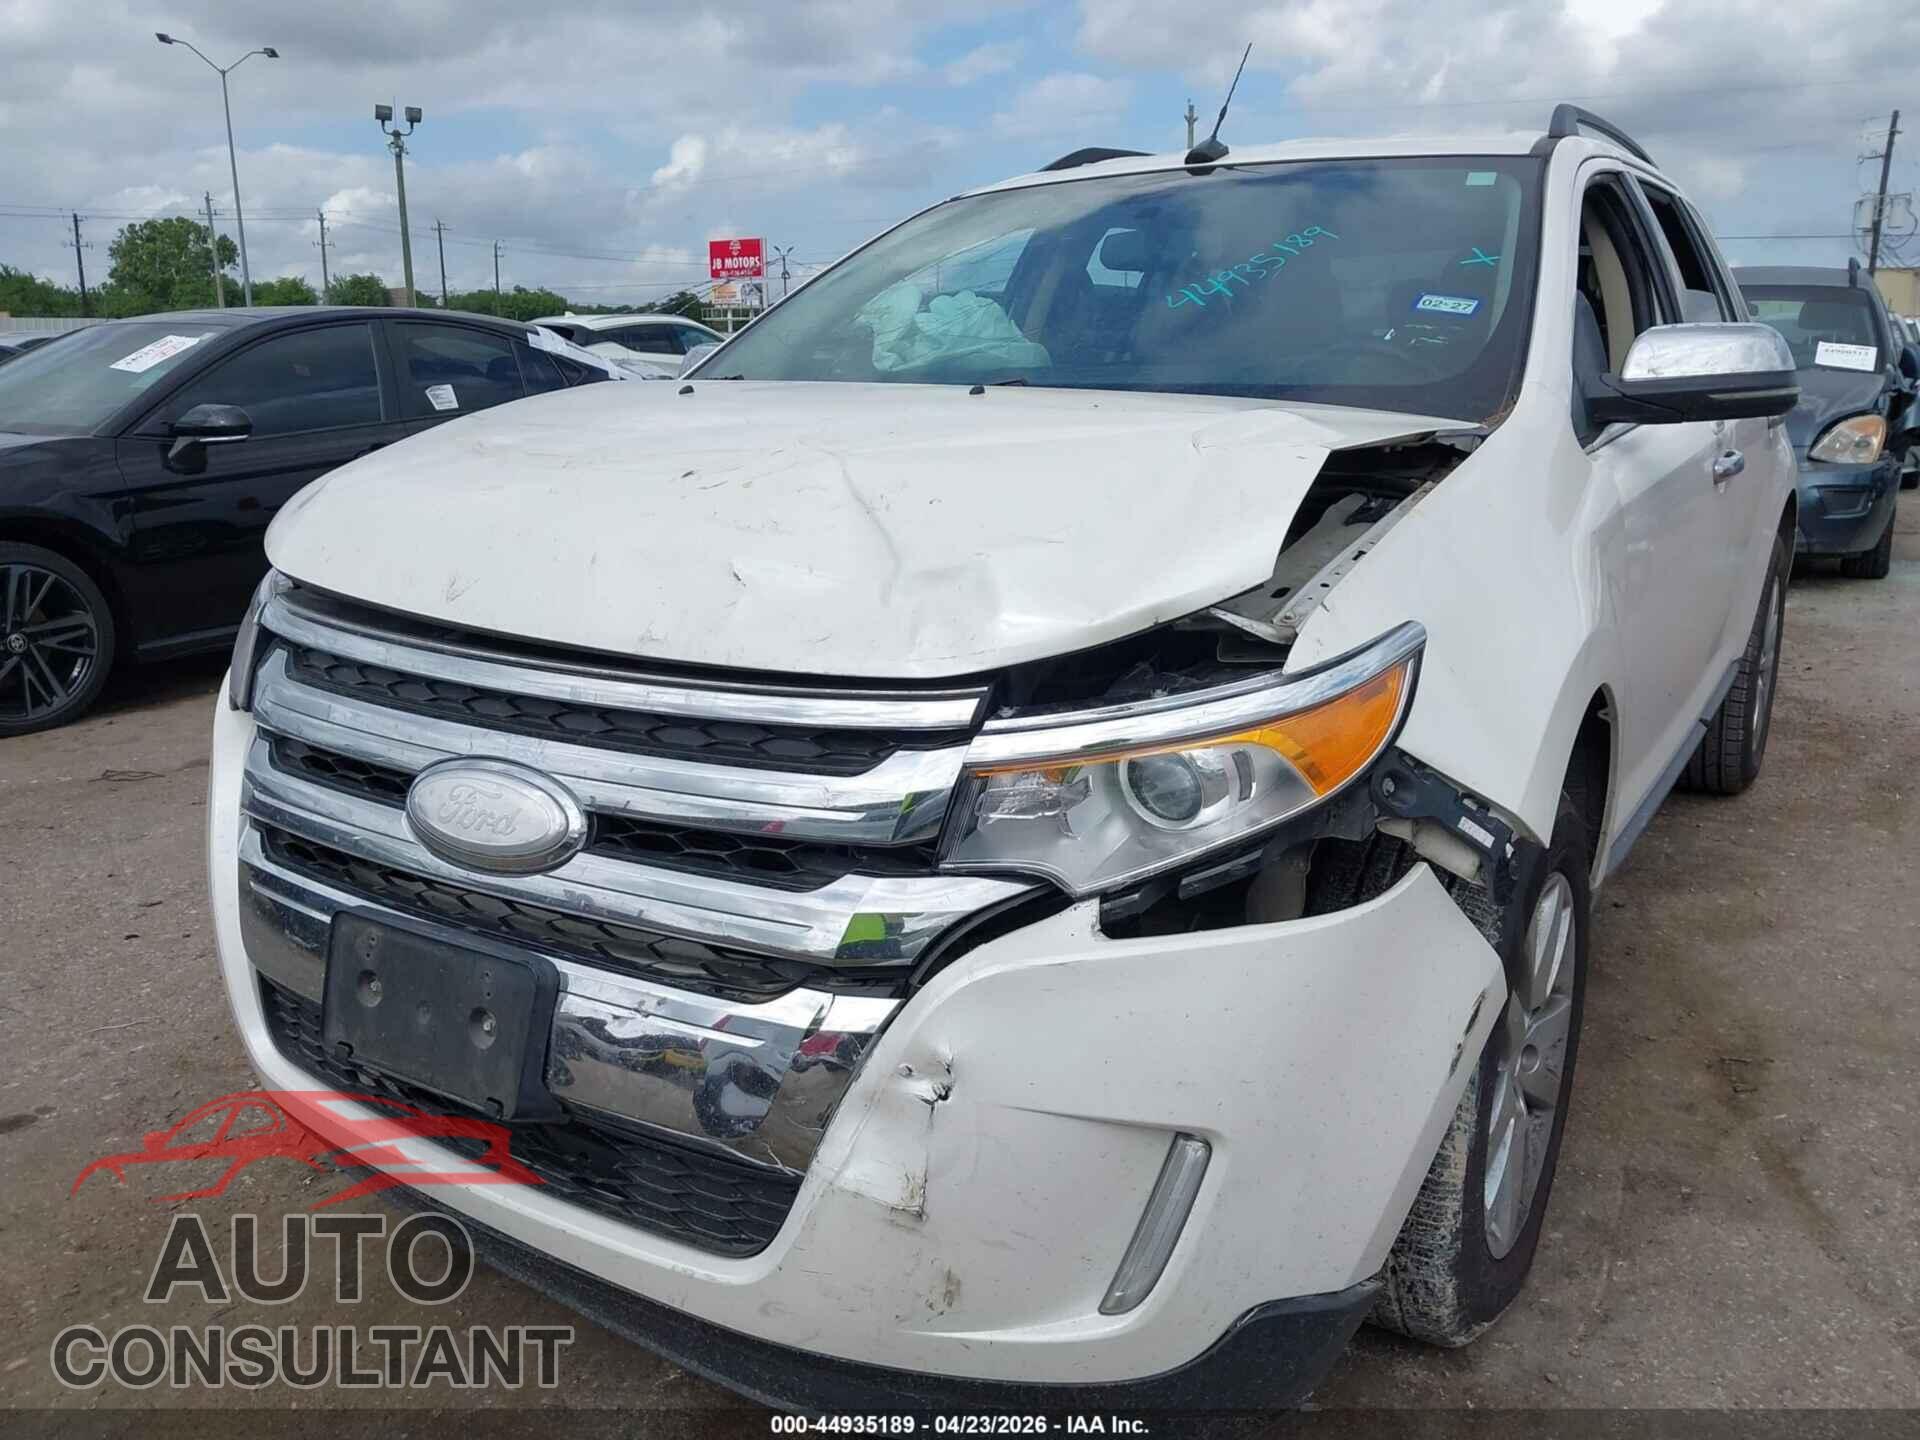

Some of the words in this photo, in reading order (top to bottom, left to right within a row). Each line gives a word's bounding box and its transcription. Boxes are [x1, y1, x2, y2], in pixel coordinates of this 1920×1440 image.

[712, 258, 723, 271] JB
[724, 256, 761, 270] MOTORS
[1166, 225, 1339, 308] 44935189
[439, 784, 522, 836] Ford
